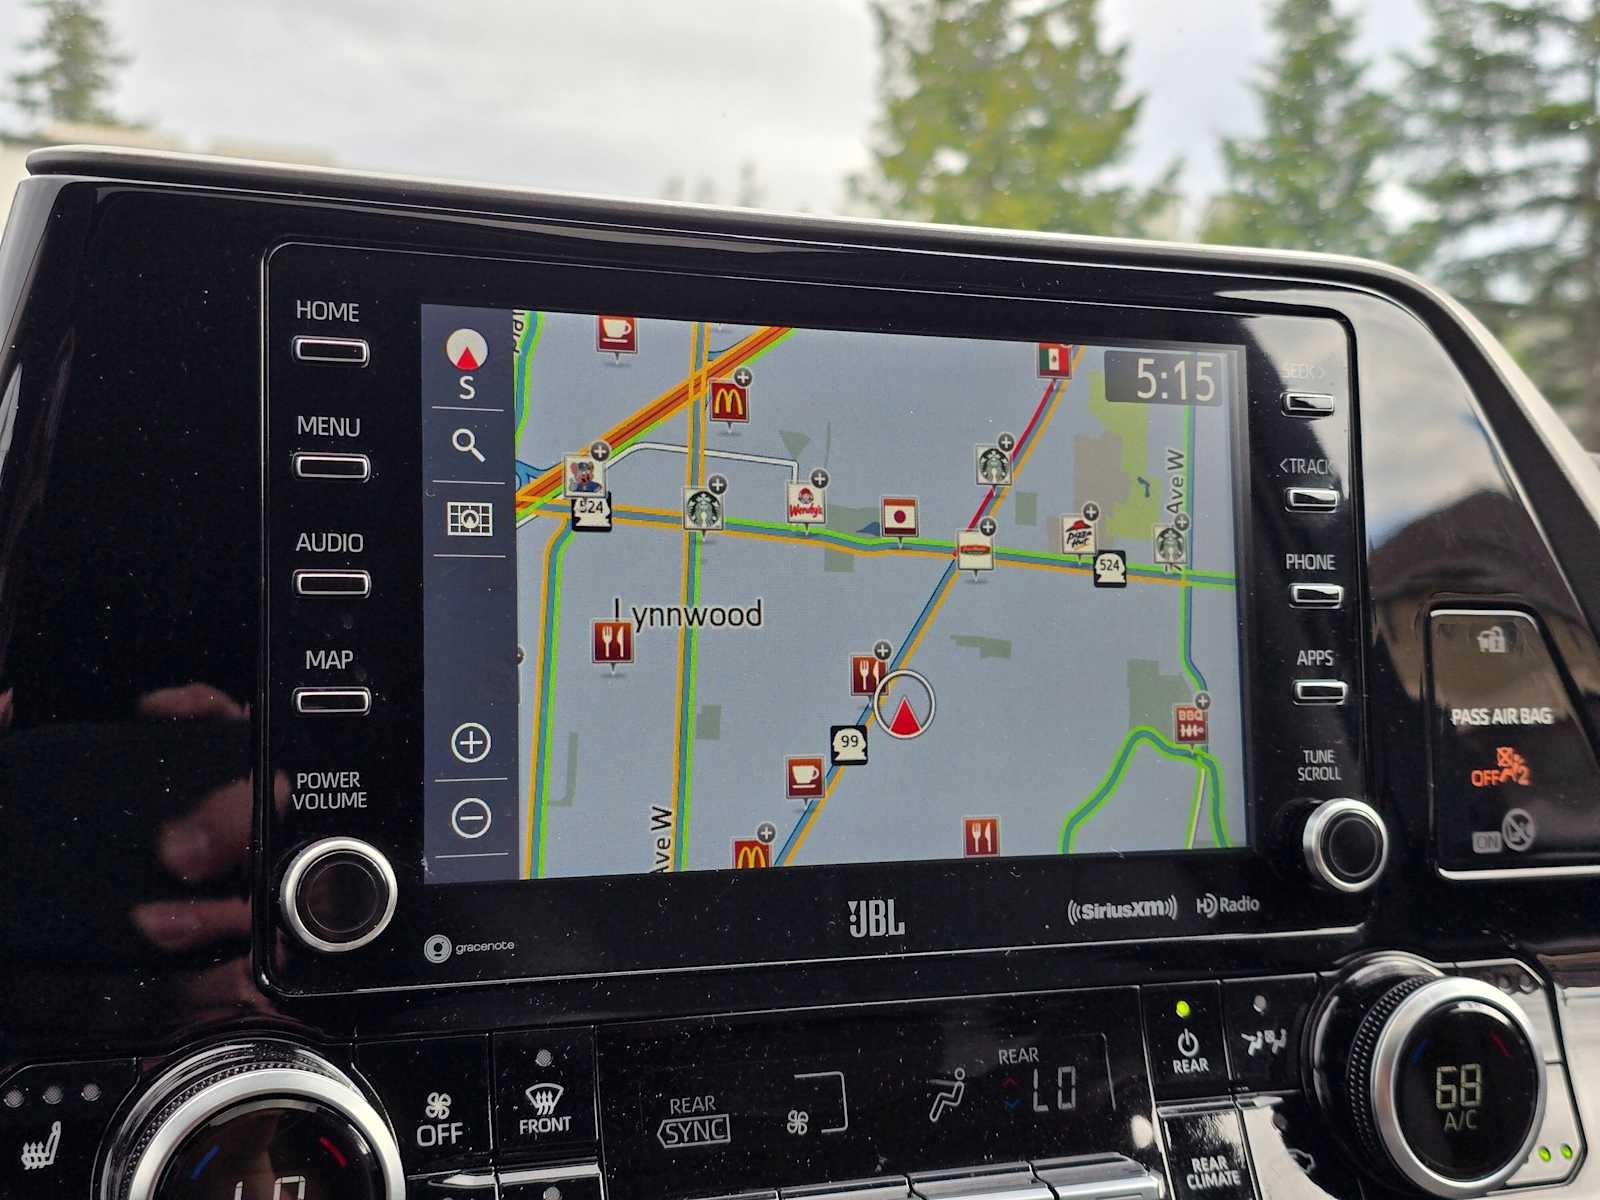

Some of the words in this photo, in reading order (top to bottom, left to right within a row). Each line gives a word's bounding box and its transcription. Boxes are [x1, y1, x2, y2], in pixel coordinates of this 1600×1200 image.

[296, 301, 360, 322] HOME
[459, 376, 476, 400] S
[1136, 358, 1216, 401] 5:15
[297, 416, 361, 437] MENU
[1167, 449, 1185, 471] W
[1166, 476, 1184, 514] Ave
[296, 533, 364, 553] AUDIO
[1099, 559, 1120, 571] 524
[1285, 553, 1337, 571] PHONE
[305, 650, 353, 670] MAP
[1297, 650, 1334, 667] APPS
[1451, 708, 1490, 726] PASS
[1492, 708, 1520, 725] AIR
[1520, 706, 1553, 725] BAG
[841, 734, 859, 748] 99
[1303, 750, 1335, 764] TUNE
[296, 771, 360, 788] POWER
[1297, 765, 1342, 781] SCROLL
[1471, 769, 1500, 787] OFF
[291, 791, 368, 810] VOLUME
[650, 805, 673, 832] W
[1476, 837, 1498, 850] ON
[1219, 895, 1260, 913] Radio
[849, 899, 906, 938] JBL
[455, 941, 515, 956] gracenote
[998, 1046, 1039, 1065] REAR
[1172, 1057, 1210, 1074] REAR
[1436, 1063, 1483, 1110] 68
[669, 1095, 717, 1115] REAR
[519, 1116, 572, 1135] FRONT
[1443, 1109, 1480, 1133] A/C
[416, 1122, 463, 1147] OFF
[664, 1122, 726, 1144] SYNC
[1191, 1155, 1229, 1173] REAR
[1186, 1170, 1241, 1190] CLIMATE
